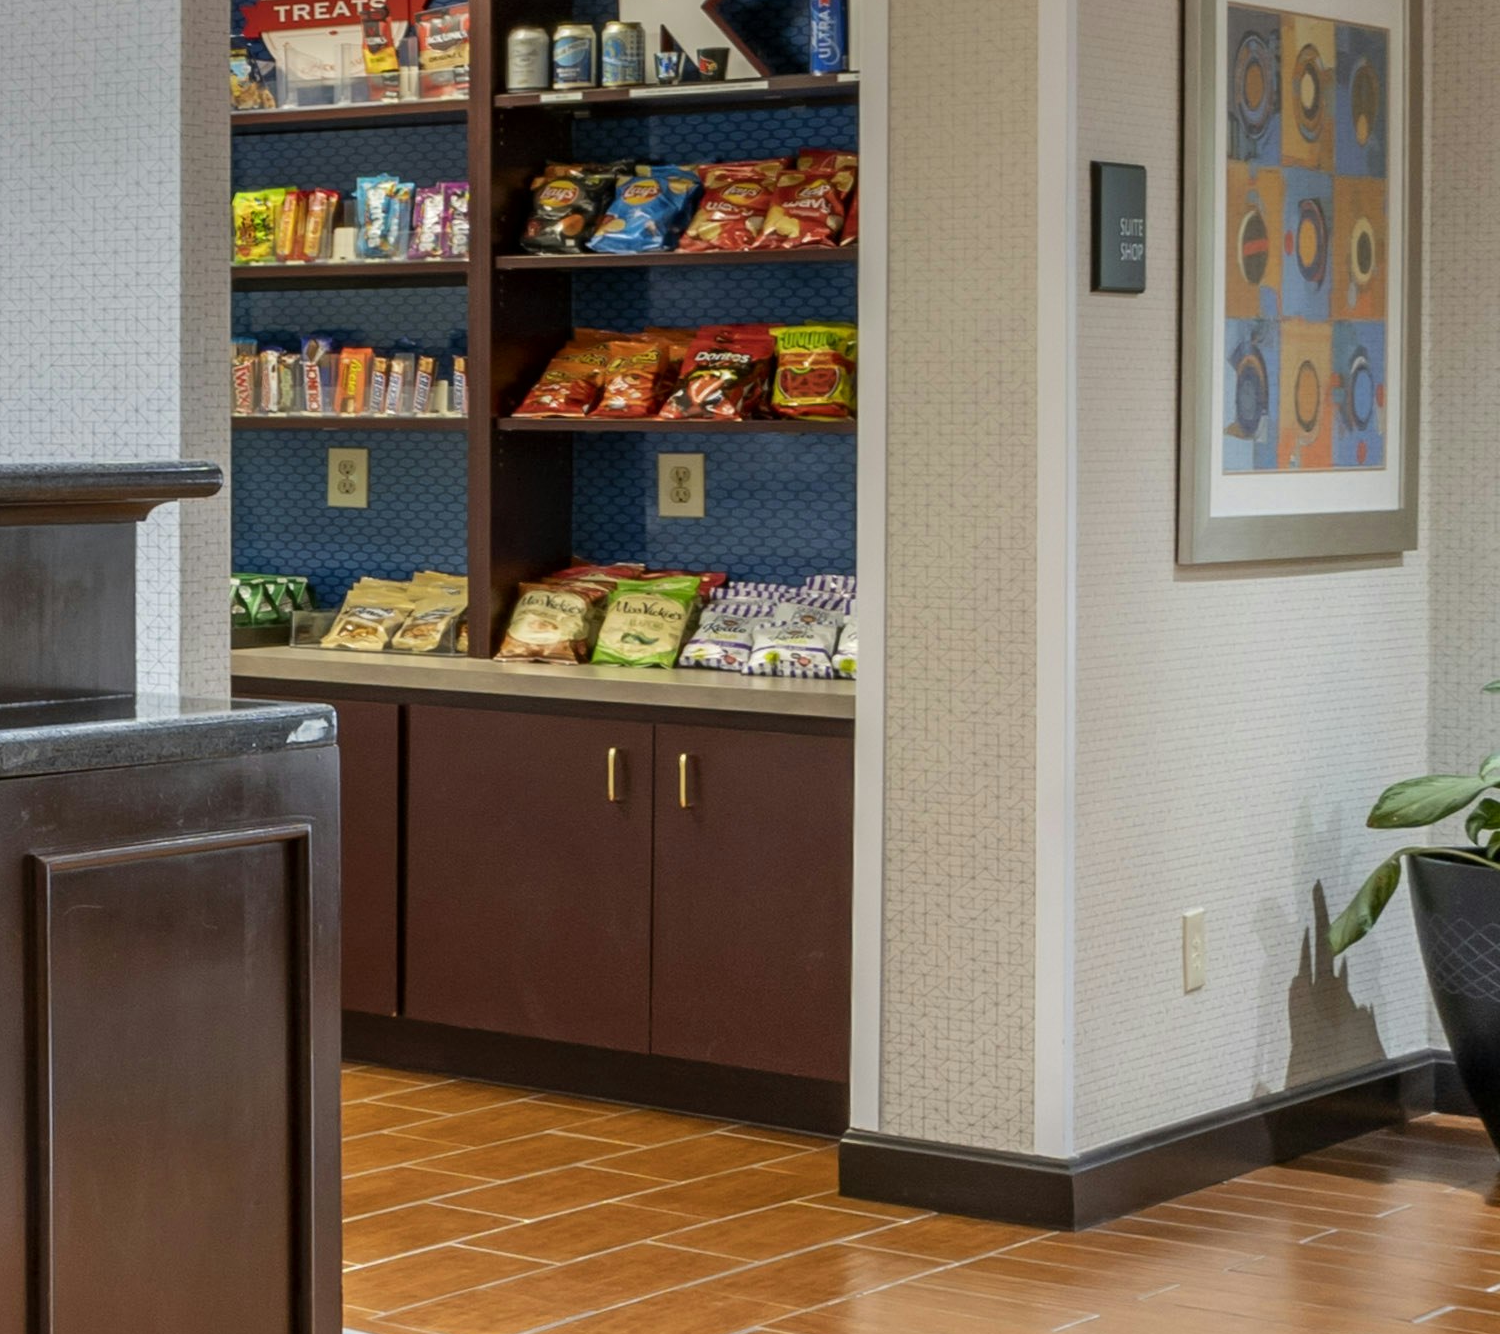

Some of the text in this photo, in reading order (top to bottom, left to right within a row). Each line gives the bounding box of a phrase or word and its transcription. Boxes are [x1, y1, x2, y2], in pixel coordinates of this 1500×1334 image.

[818, 9, 832, 58] ULTRA
[1120, 217, 1143, 237] SUITE
[1120, 242, 1143, 261] SHOP
[694, 350, 750, 364] Doritos
[305, 364, 321, 412] CRUNCH
